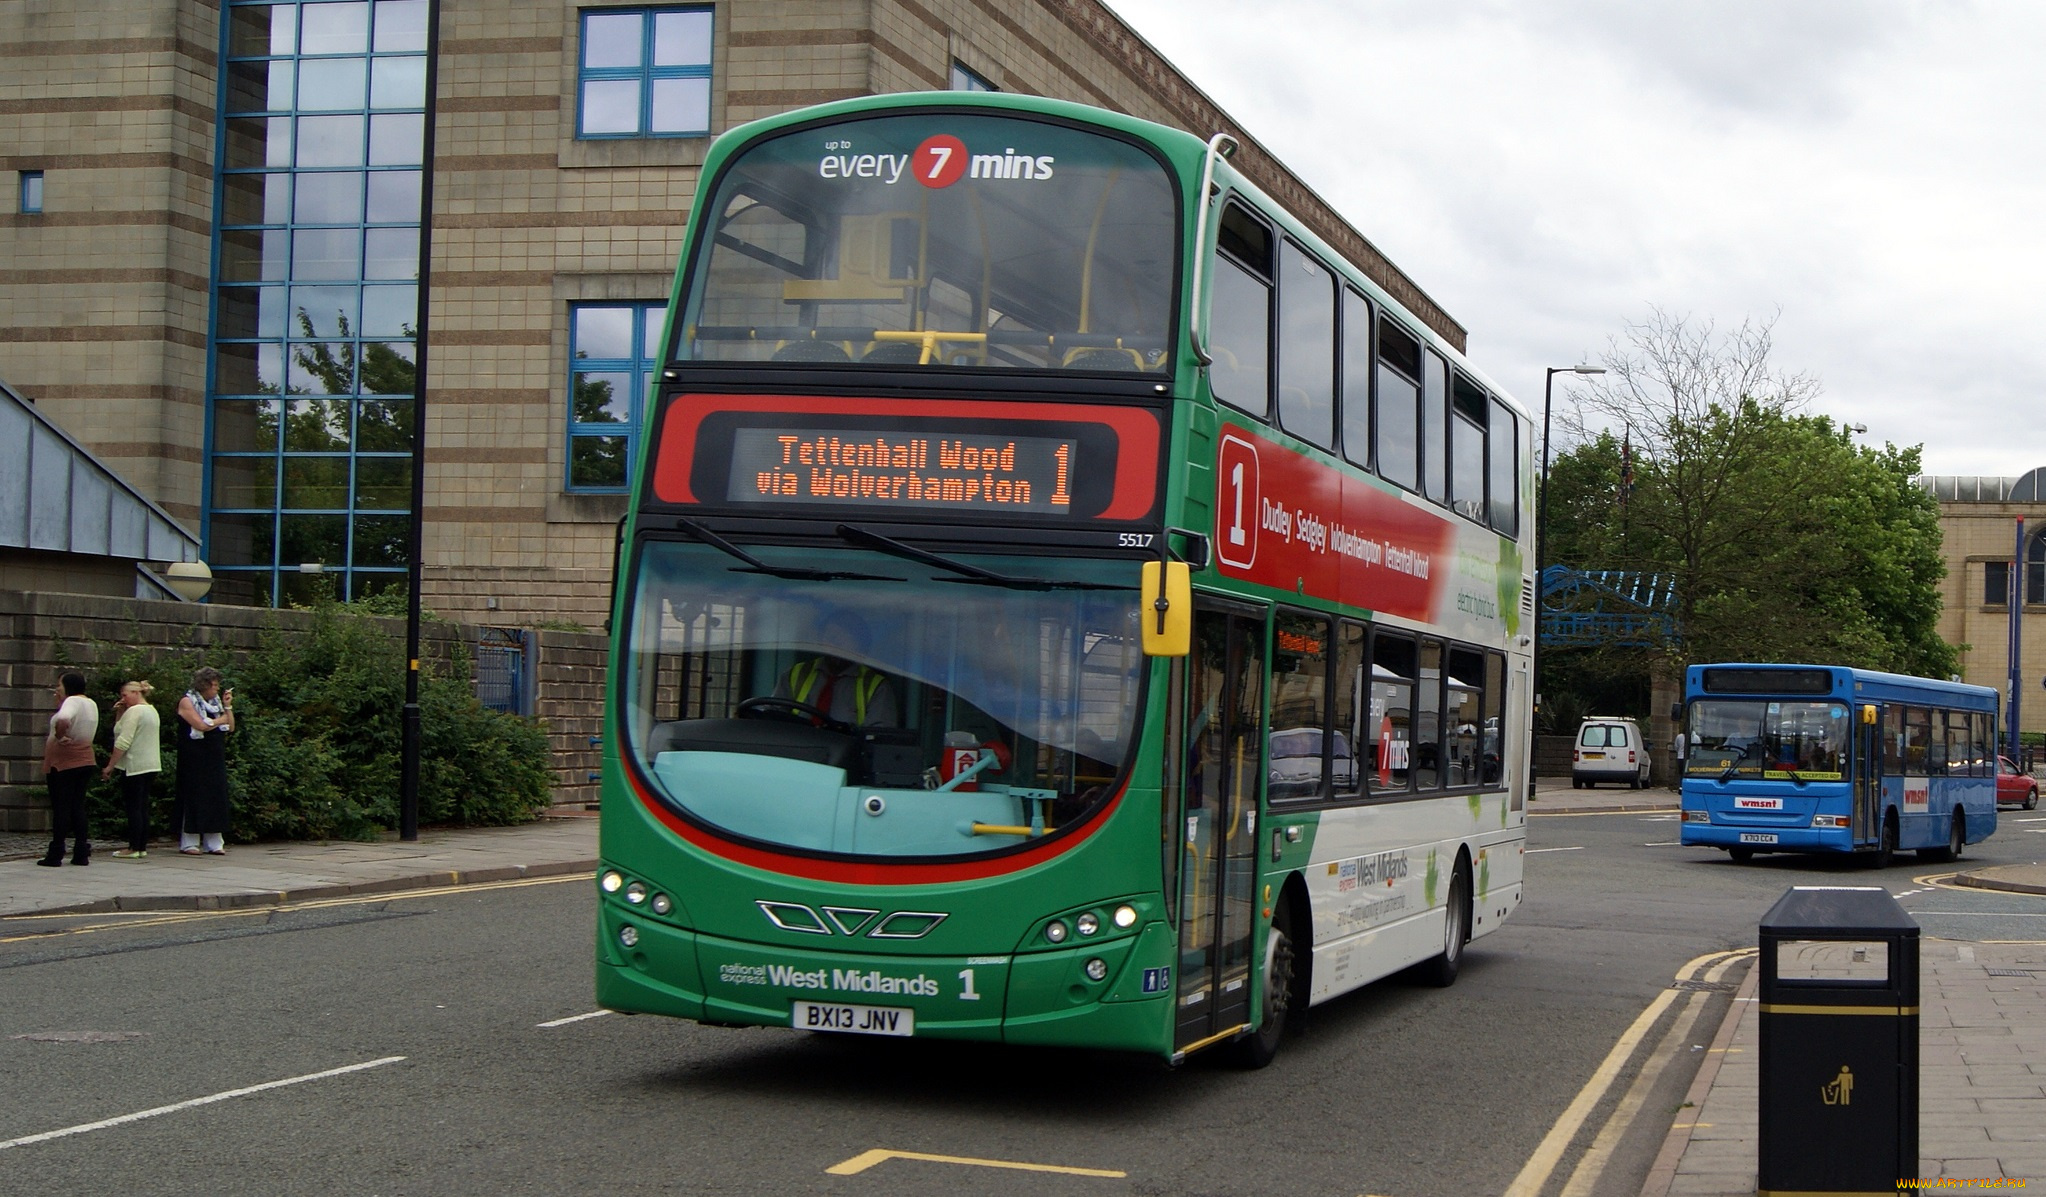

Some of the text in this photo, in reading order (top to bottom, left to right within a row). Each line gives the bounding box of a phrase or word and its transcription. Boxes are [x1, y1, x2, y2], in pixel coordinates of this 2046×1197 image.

[825, 139, 852, 151] up to
[819, 147, 1055, 185] every 7 mins
[778, 435, 1016, 472] Tettenhall Wood
[756, 466, 1031, 504] via Wolverhampton
[1051, 443, 1070, 505] 1
[1229, 462, 1246, 547] 1
[1118, 532, 1154, 547] 5517
[1262, 496, 1293, 544] Dudley
[1296, 509, 1328, 555] Sedgley
[1330, 521, 1382, 569] Wolverhampton
[1384, 540, 1413, 577] Tettenhall
[1413, 550, 1430, 580] Wood
[1383, 730, 1410, 770] 7 mins
[1720, 759, 1731, 768] 61
[1741, 799, 1777, 808] wmsnt
[1904, 786, 1928, 805] wmsnt
[1357, 850, 1408, 888] West Midlands
[720, 962, 766, 976] national
[720, 973, 767, 986] express
[768, 964, 939, 996] West Midlands
[958, 968, 980, 1000] 1
[807, 1005, 900, 1031] BX13 JNV
